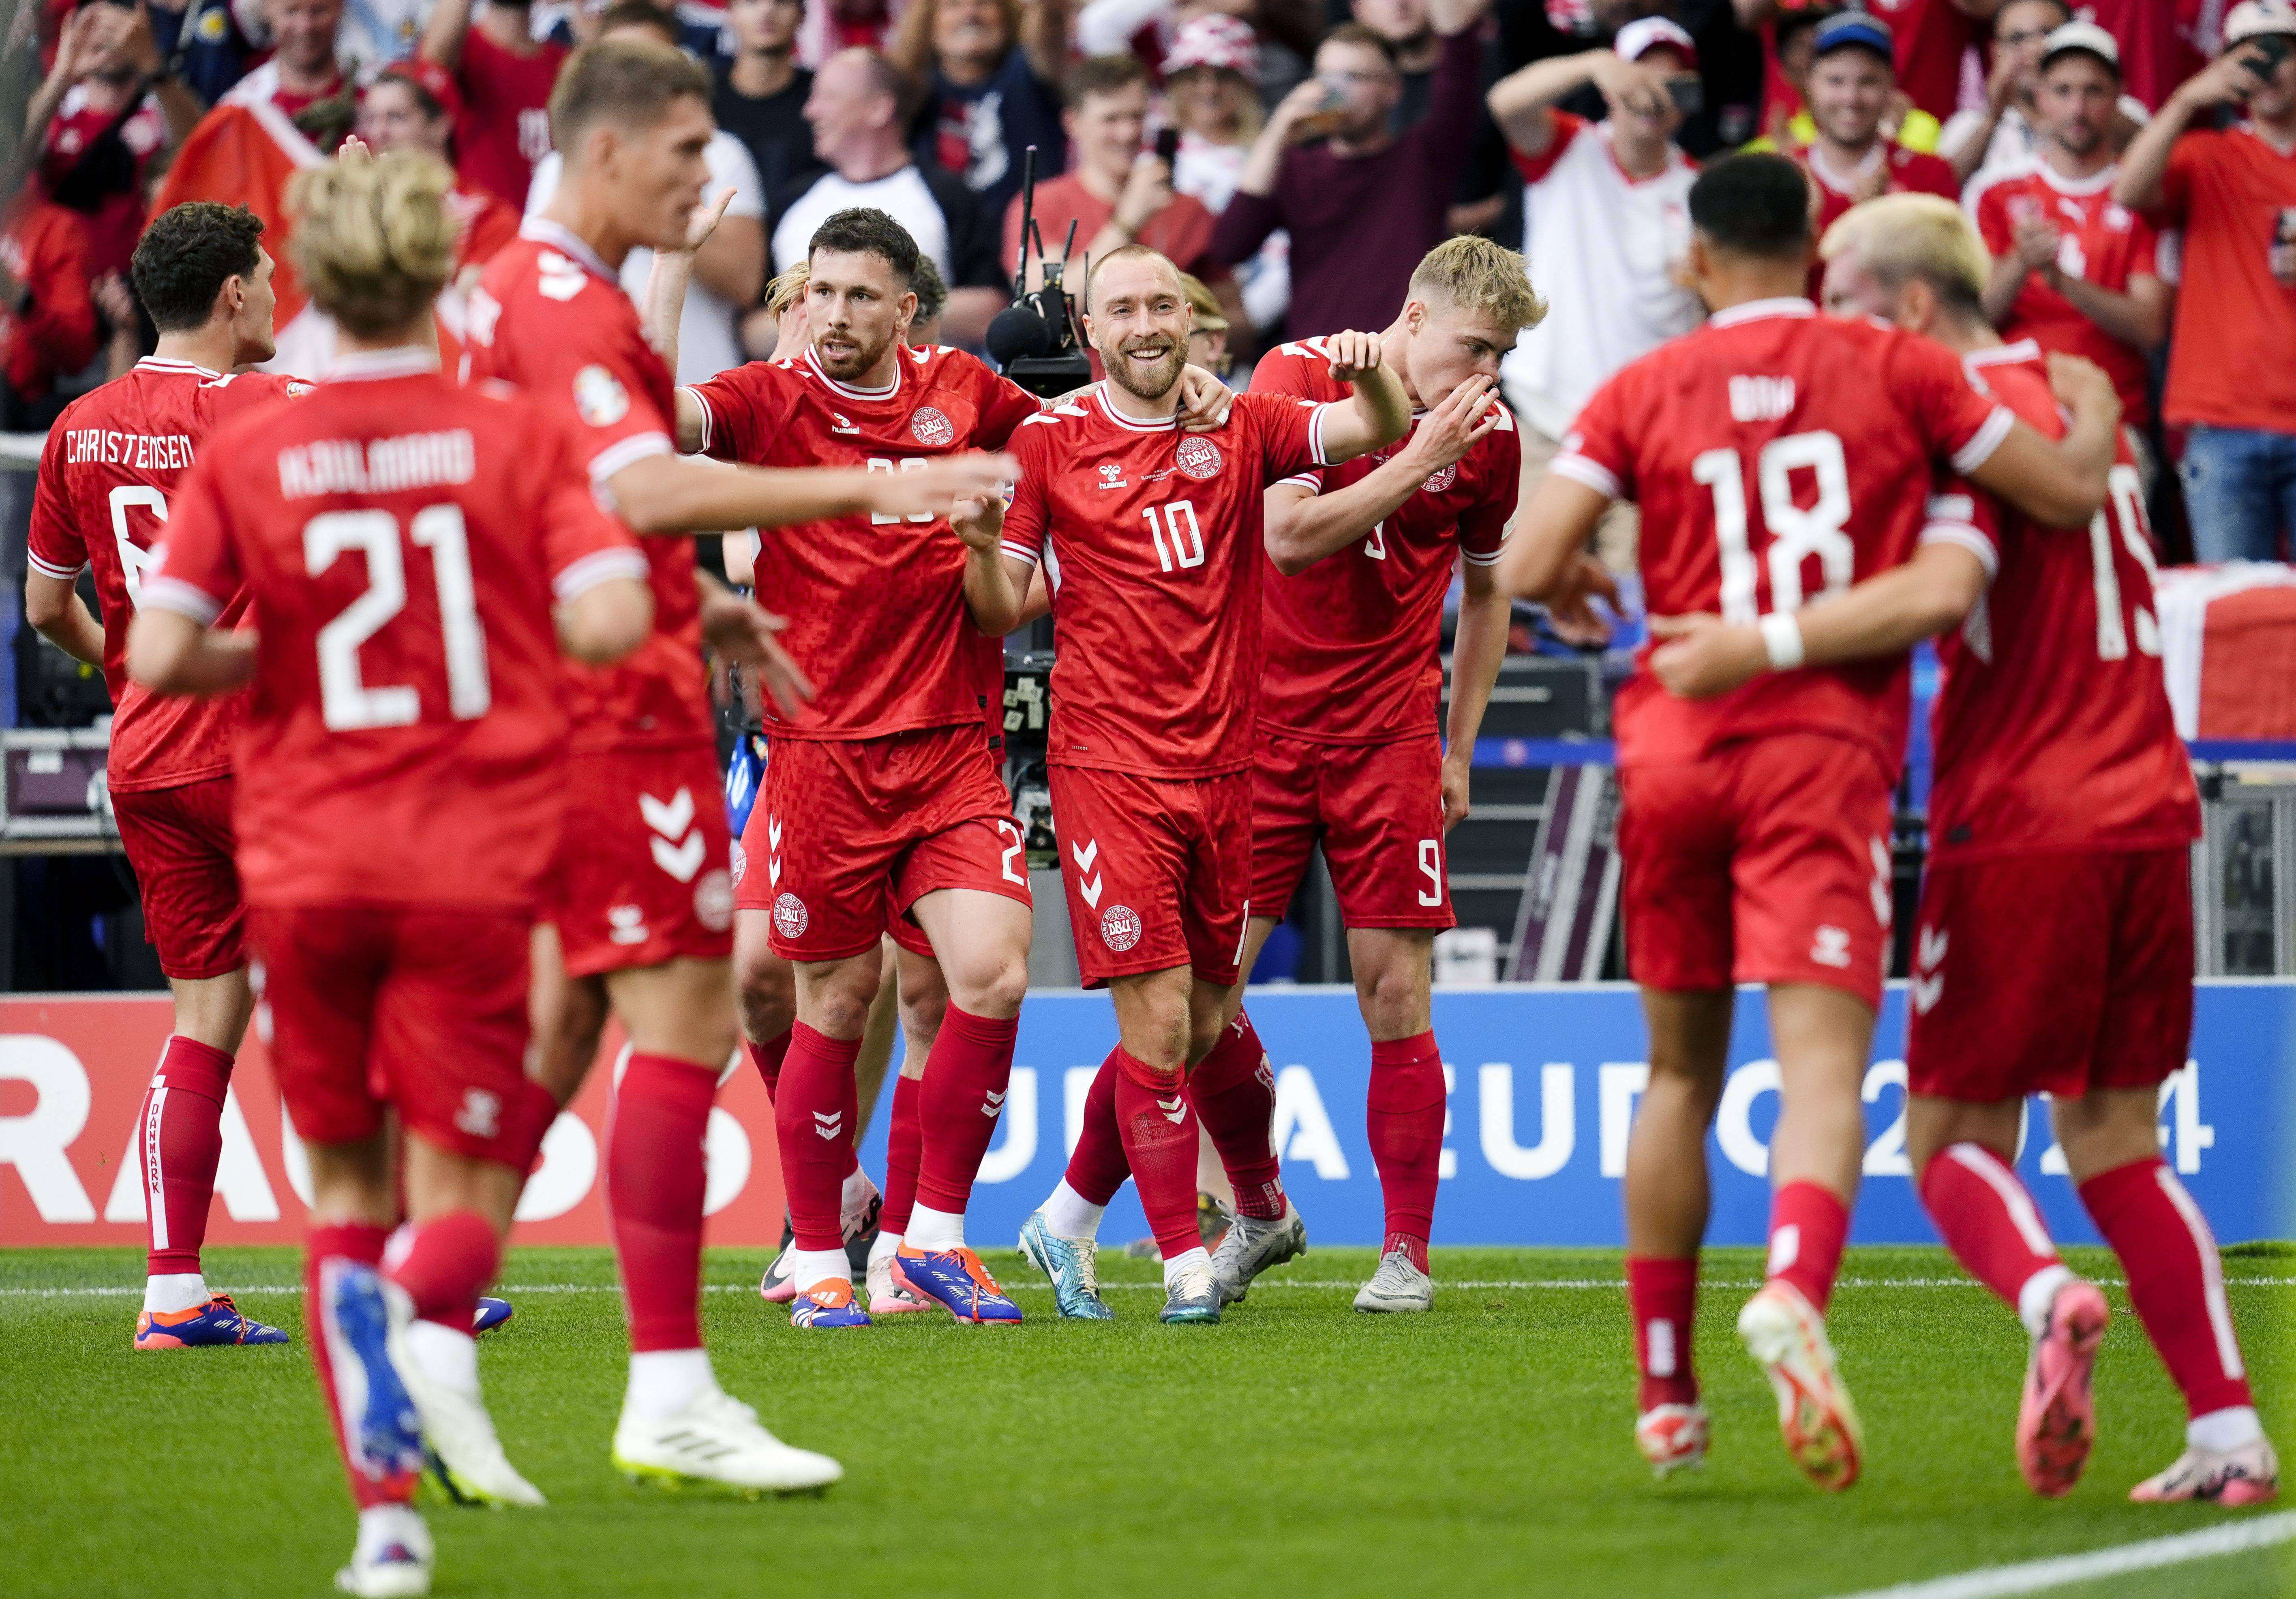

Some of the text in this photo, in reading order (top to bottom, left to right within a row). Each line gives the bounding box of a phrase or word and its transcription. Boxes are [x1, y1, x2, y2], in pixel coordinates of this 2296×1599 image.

[66, 429, 196, 469] CHRISTENSEN
[832, 425, 860, 434] hummel
[919, 418, 944, 436] DBU
[1185, 448, 1212, 467] DBU
[1099, 479, 1128, 490] hummel
[1142, 500, 1204, 572] 10
[1692, 430, 1854, 630] 18
[303, 503, 492, 732] 21
[998, 819, 1031, 894] 2
[1419, 839, 1441, 906] 9
[780, 907, 799, 923] DBU
[1108, 919, 1132, 936] DBU
[972, 1058, 2215, 1183] UA UO 24
[150, 1104, 160, 1194] DANMARK
